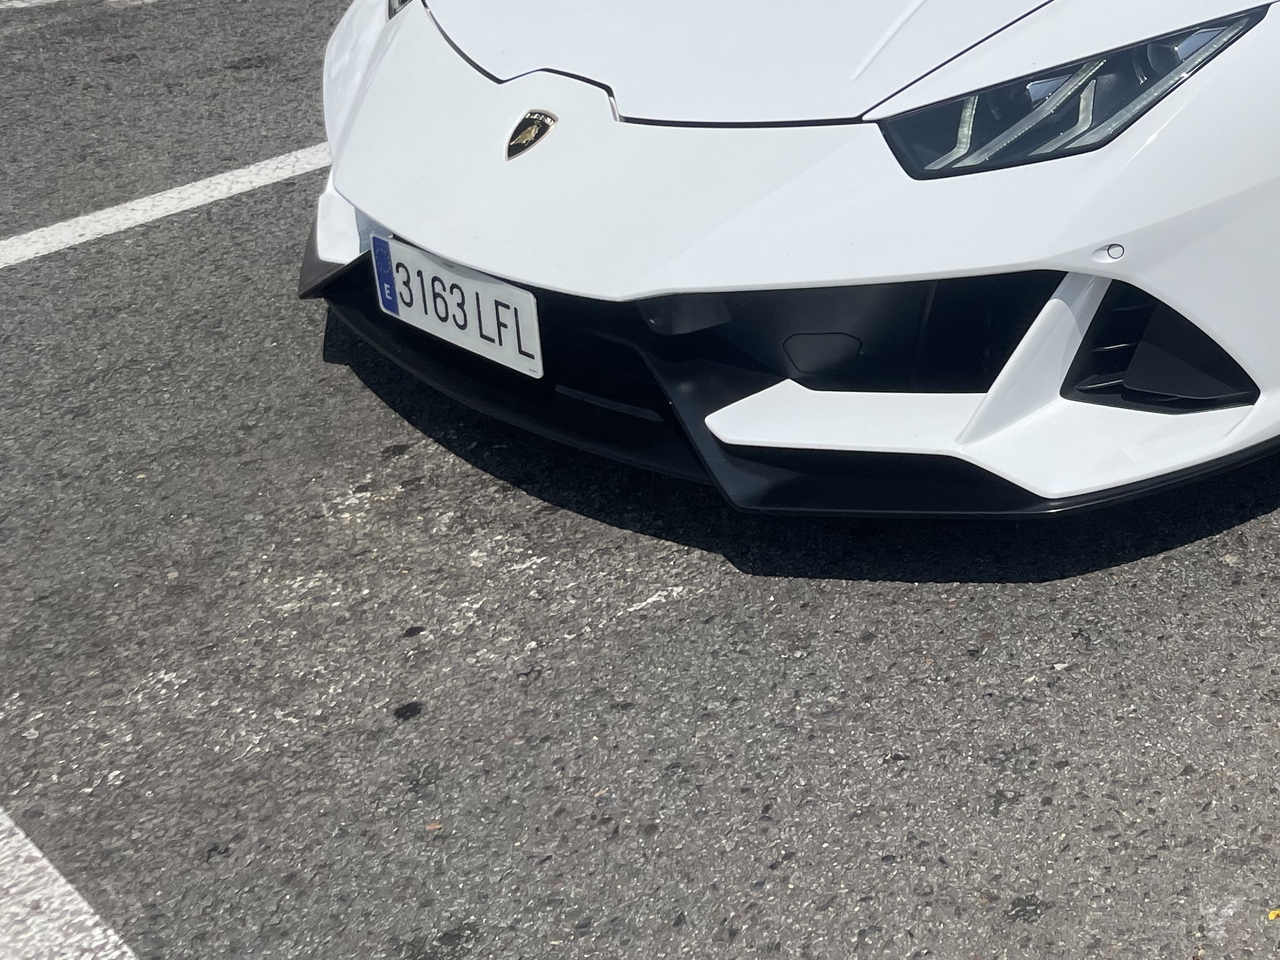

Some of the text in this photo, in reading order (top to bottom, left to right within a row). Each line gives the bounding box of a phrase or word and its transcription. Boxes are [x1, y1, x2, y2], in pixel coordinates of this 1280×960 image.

[383, 283, 393, 301] E
[396, 262, 536, 360] 3163 LFL
